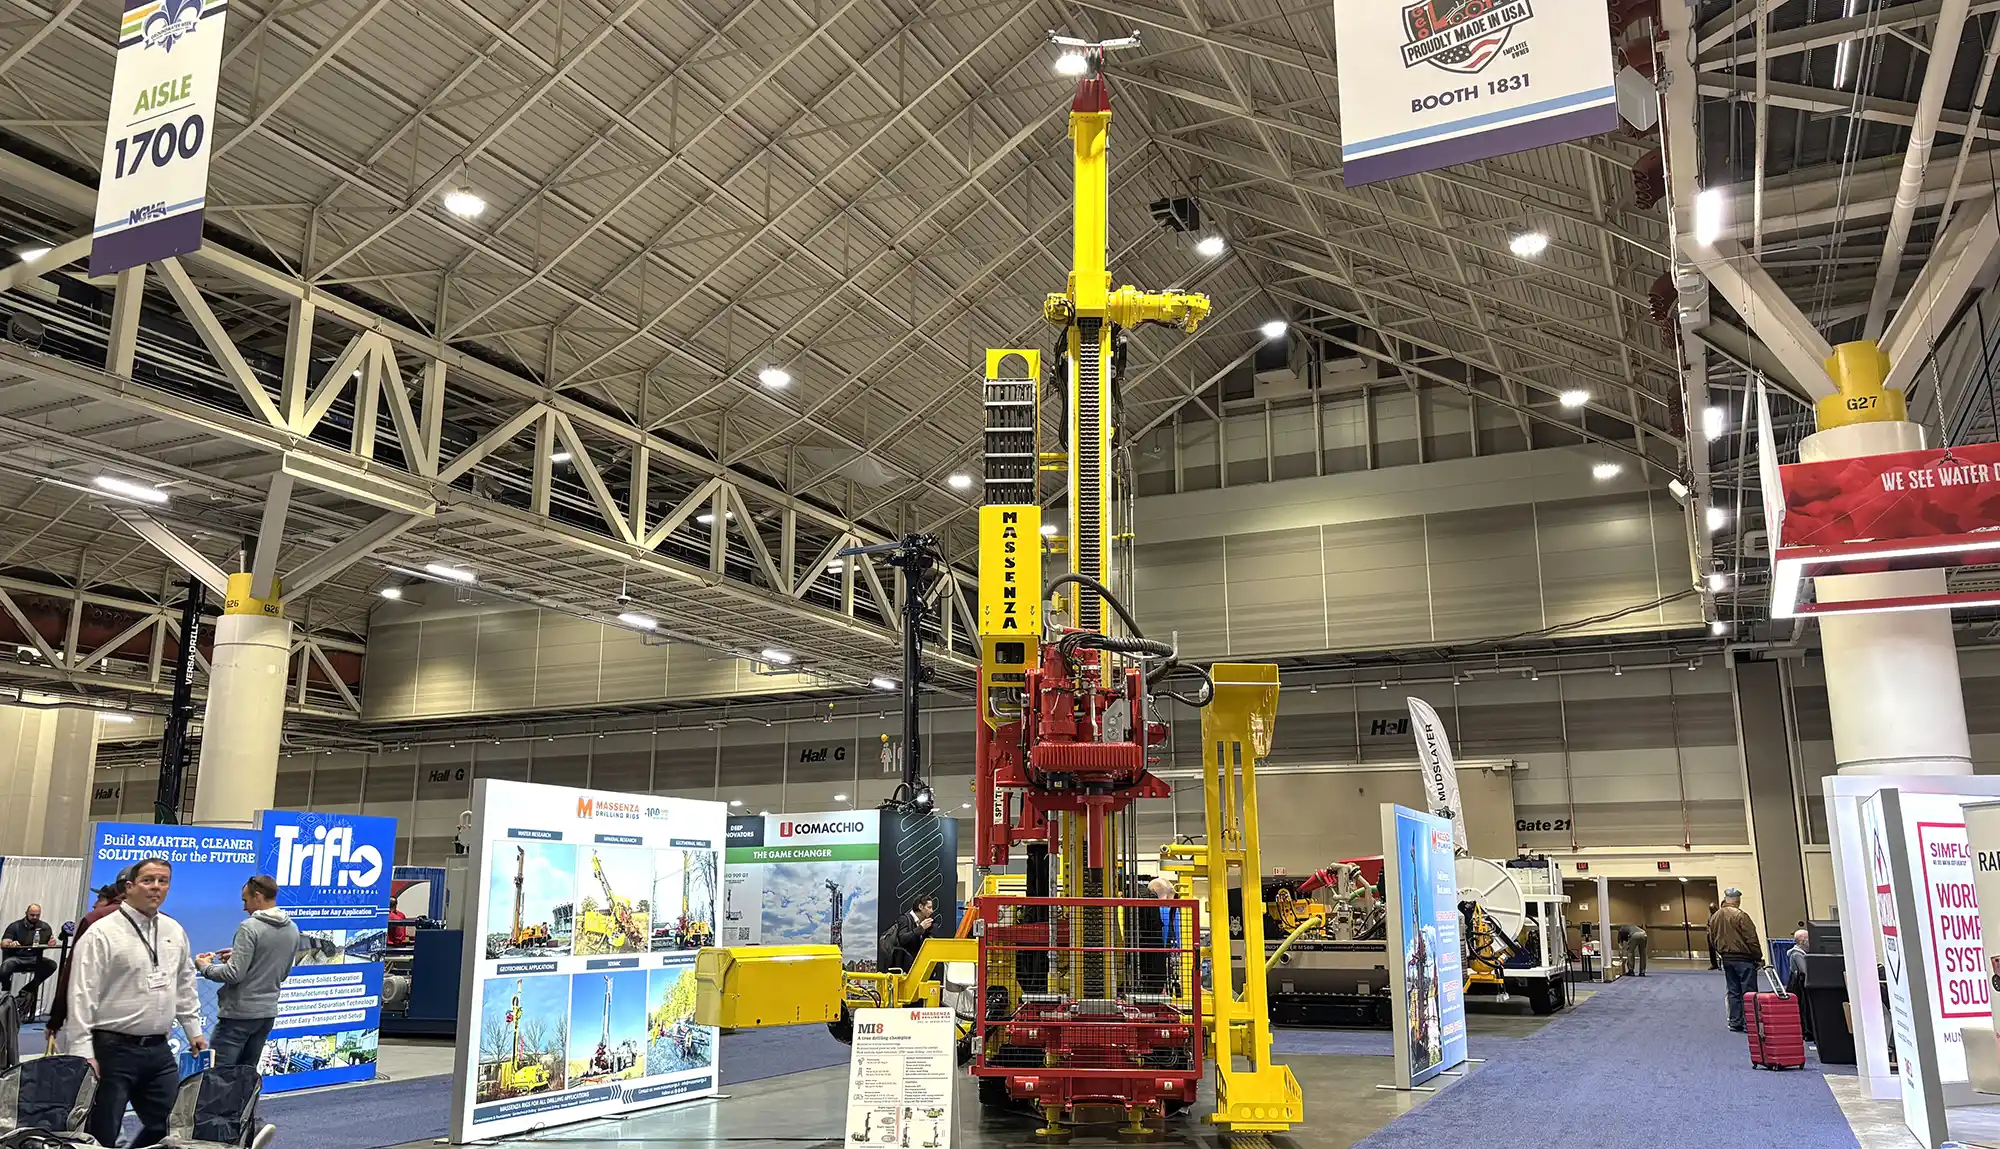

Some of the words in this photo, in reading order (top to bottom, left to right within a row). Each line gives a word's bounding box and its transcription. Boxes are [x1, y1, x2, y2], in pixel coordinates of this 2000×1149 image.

[1407, 29, 1452, 62] PROUDLY
[1453, 18, 1487, 43] MADE
[1487, 12, 1501, 29] IN
[1501, 3, 1526, 23] USA
[1511, 48, 1530, 59] OWNED
[133, 74, 192, 115] AISLE
[1411, 85, 1479, 113] BOOTH
[1487, 73, 1530, 95] 1831
[115, 114, 204, 179] 1700
[1847, 395, 1878, 411] G27
[1881, 471, 1905, 491] WE
[1908, 468, 1935, 489] SEE
[1938, 464, 1990, 487] WATER
[1002, 511, 1018, 630] MASSENZA
[263, 603, 281, 614] G26
[1371, 718, 1408, 735] Hall
[800, 747, 828, 763] Hall
[834, 746, 846, 761] G
[1425, 723, 1446, 802] MUDSLAYER
[428, 769, 451, 782] Hall
[455, 768, 465, 781] G
[95, 788, 113, 800] Hall
[595, 801, 640, 813] MASSENZA
[595, 810, 624, 819] DRILLING
[625, 812, 640, 820] RIGS
[795, 821, 864, 835] COMACCHIO
[1516, 820, 1551, 831] Gate
[1554, 819, 1572, 831] 21
[103, 834, 136, 847] Build
[138, 836, 199, 850] SMARTER,
[201, 838, 254, 851] CLEANER
[98, 849, 169, 862] SOLUTIONS
[171, 849, 188, 862] for
[190, 851, 208, 863] the
[209, 852, 256, 864] FUTURE
[274, 825, 383, 888] Triflo
[753, 851, 768, 859] THE
[768, 850, 792, 859] GAME
[792, 849, 832, 858] CHANGER
[1936, 883, 1979, 908] WORL
[298, 909, 321, 917] Designs
[321, 908, 330, 916] for
[330, 909, 342, 917] Any
[341, 908, 372, 917] Application
[333, 974, 360, 982] Separation
[290, 989, 329, 998] Manufacturing
[334, 987, 363, 995] Fabrication
[1949, 979, 1989, 1005] SOLU
[318, 1001, 346, 1009] Separation
[346, 999, 375, 1007] Technology
[298, 1017, 312, 1025] Easy
[312, 1014, 338, 1023] Transport
[348, 1012, 363, 1020] Setup
[857, 1023, 884, 1034] MI8
